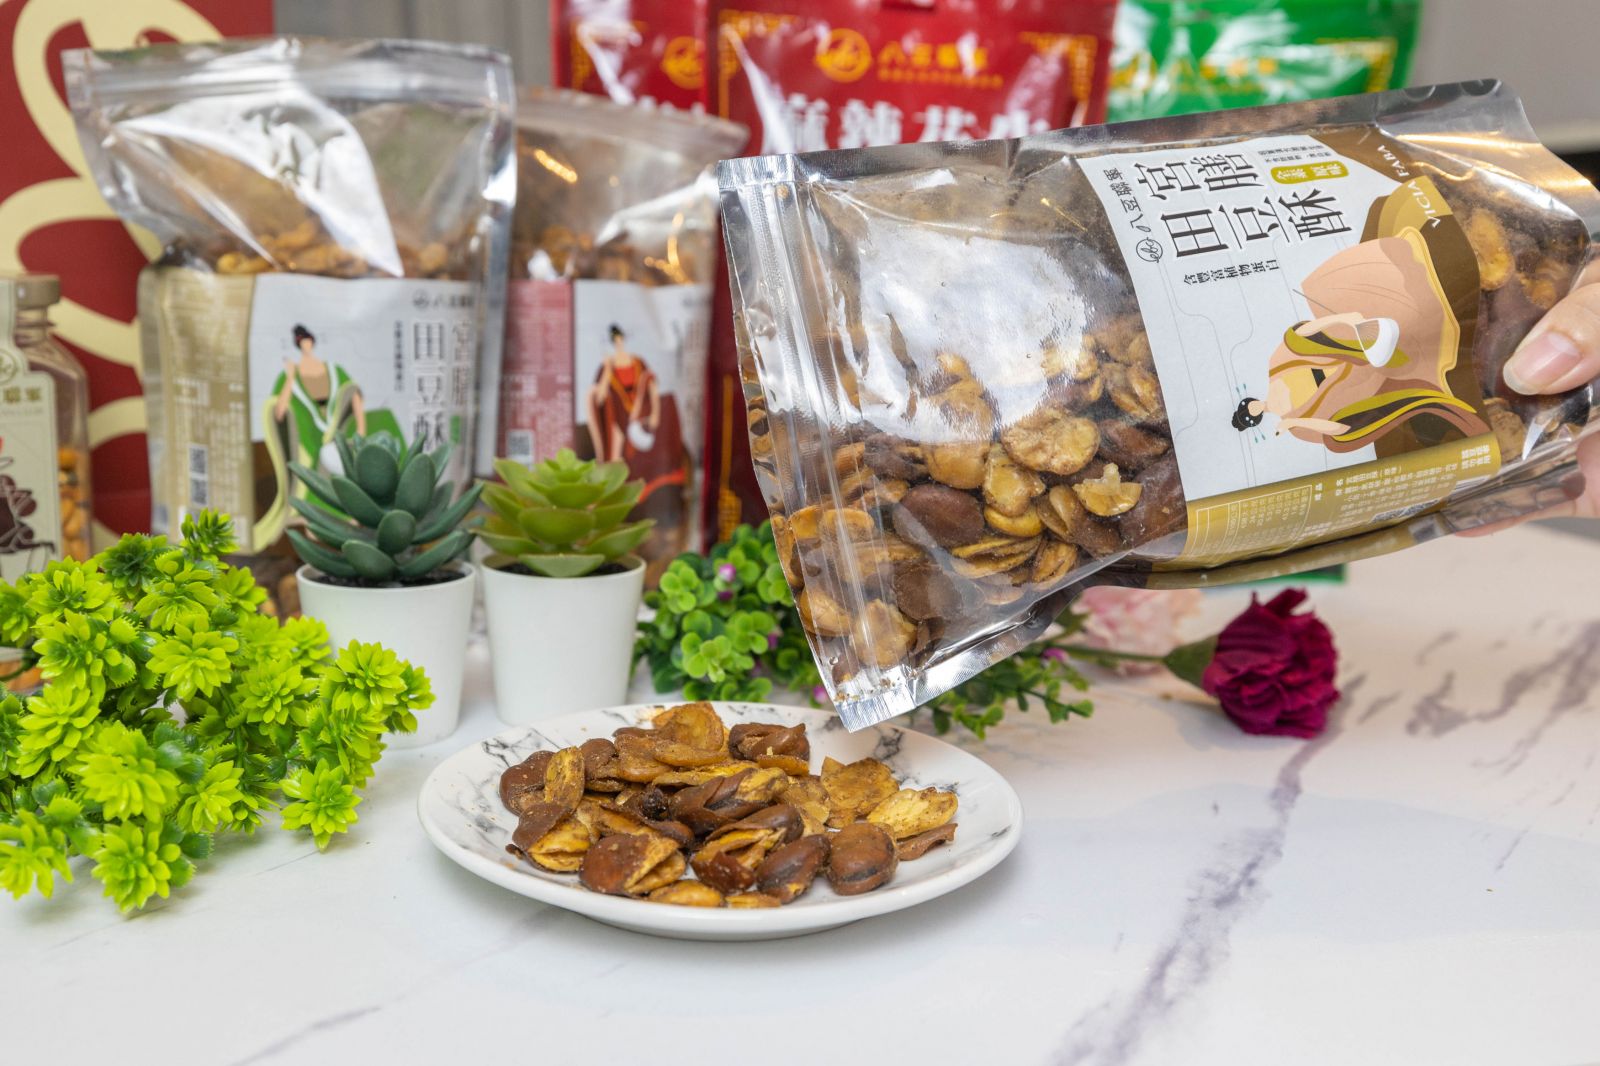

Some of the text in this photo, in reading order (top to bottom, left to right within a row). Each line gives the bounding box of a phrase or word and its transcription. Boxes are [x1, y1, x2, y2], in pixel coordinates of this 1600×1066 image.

[1103, 168, 1151, 233] 八豆聯軍
[1134, 154, 1264, 200] 宮膳
[1377, 144, 1440, 229] VICIA FABA
[1161, 189, 1352, 257] 田豆酥
